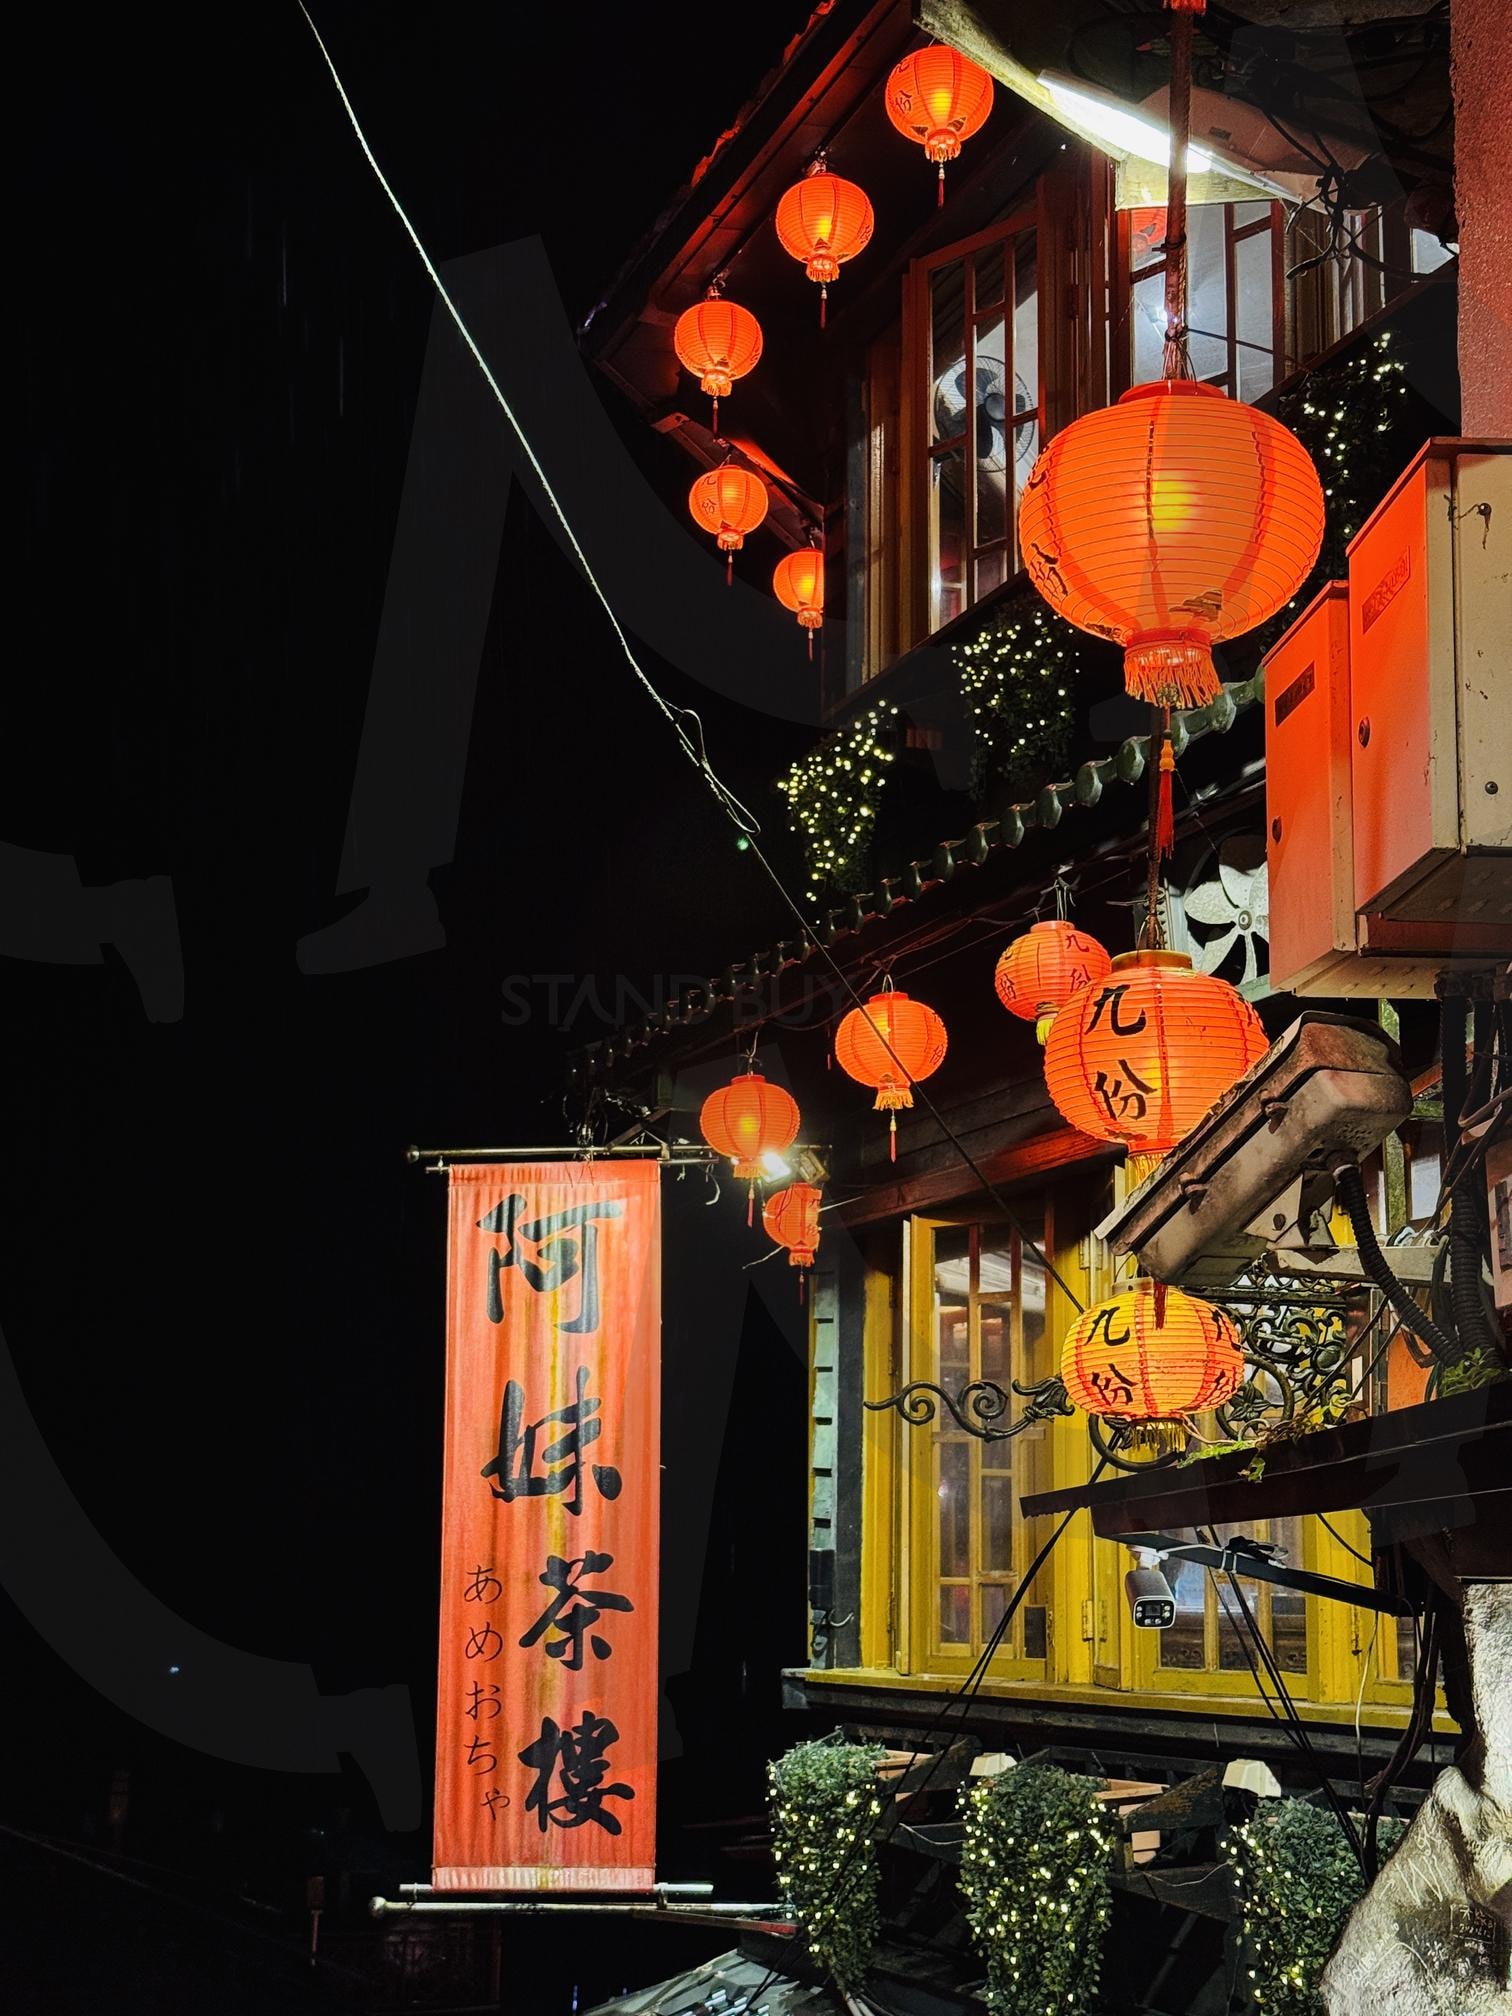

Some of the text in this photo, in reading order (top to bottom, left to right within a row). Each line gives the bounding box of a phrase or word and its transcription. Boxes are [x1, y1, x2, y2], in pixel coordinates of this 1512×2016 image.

[1066, 934, 1091, 993] 九份
[1085, 984, 1158, 1121] 九份
[1083, 1306, 1139, 1406] 九份
[475, 1193, 635, 1836] 阿妹茶樓
[464, 1566, 511, 1822] あめおちゃ
